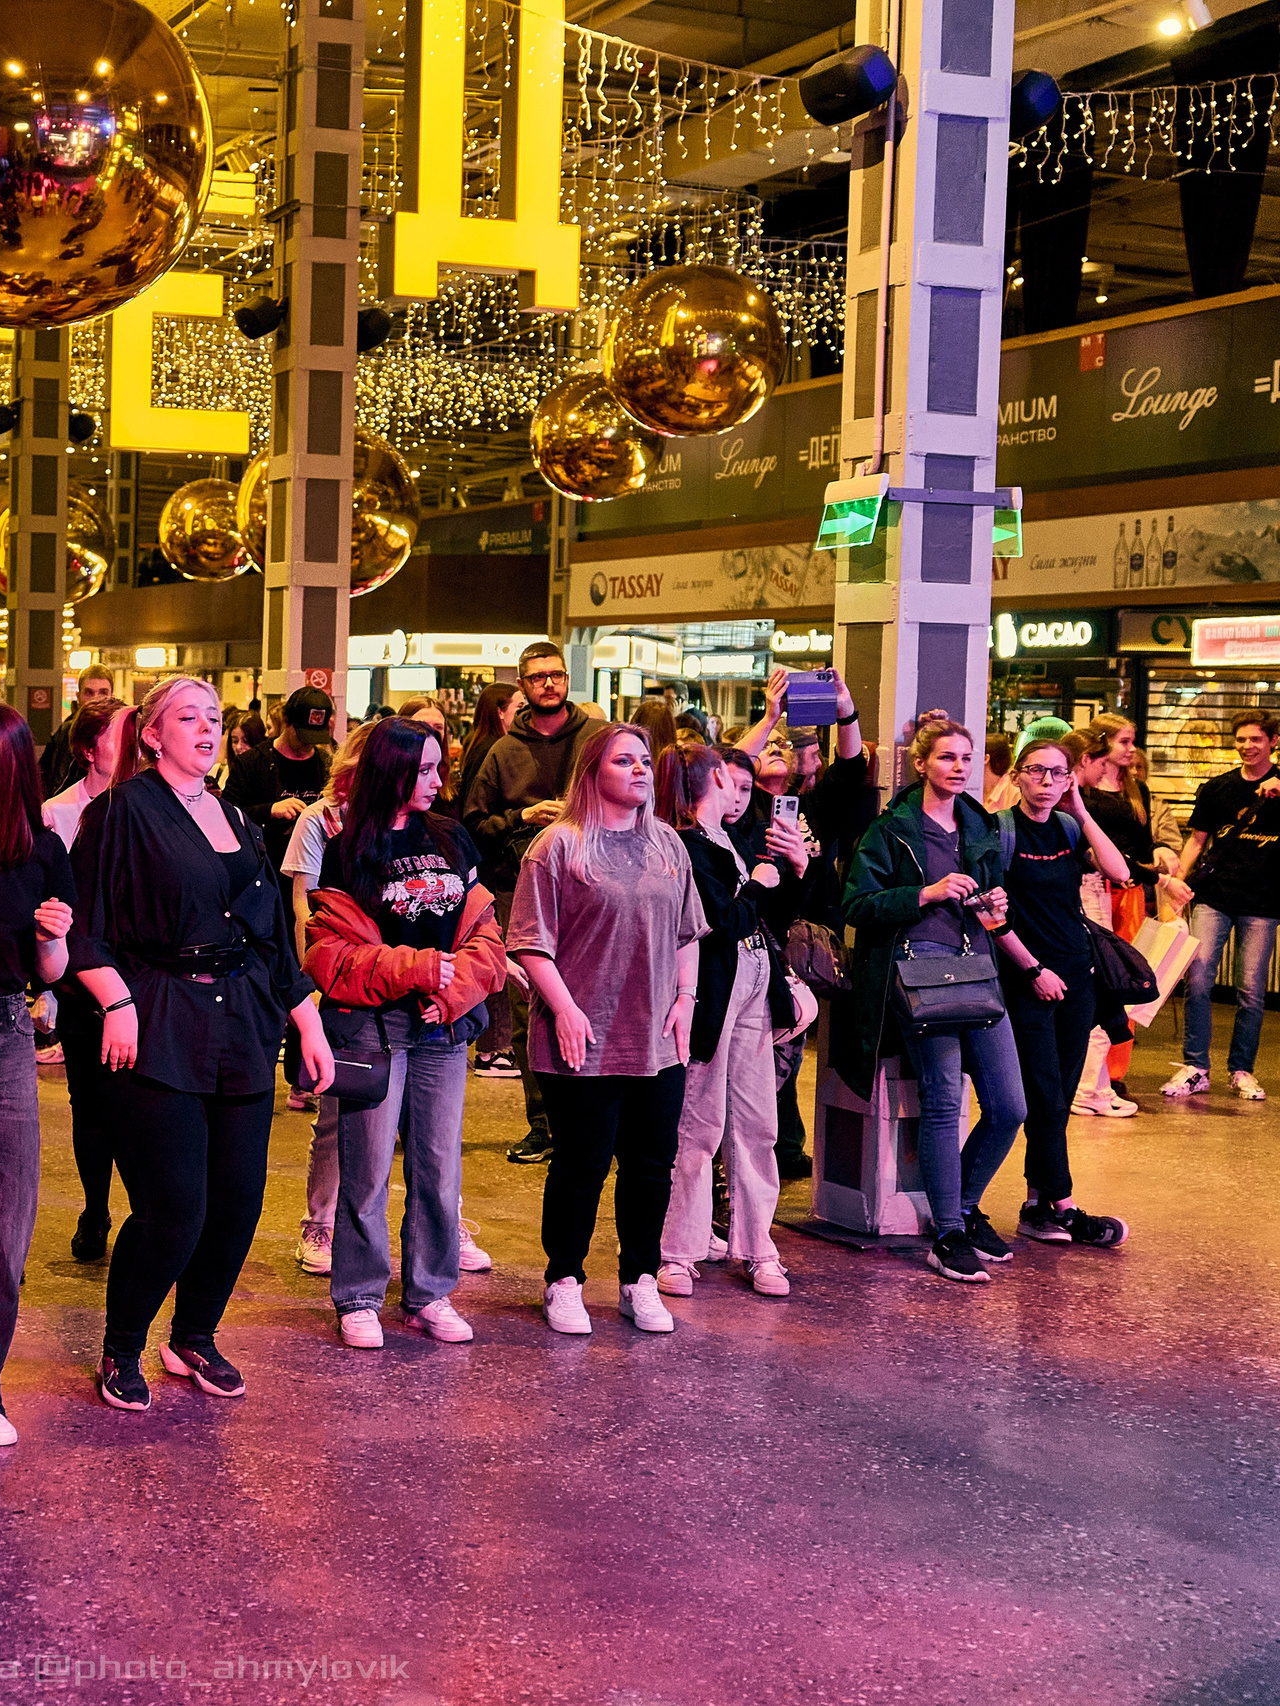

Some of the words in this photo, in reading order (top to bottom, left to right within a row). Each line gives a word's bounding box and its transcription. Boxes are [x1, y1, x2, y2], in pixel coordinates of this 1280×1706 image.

[998, 394, 1058, 426] MIUM
[1111, 366, 1219, 432] Lounge
[715, 437, 778, 488] Lounge
[609, 573, 664, 600] TASSAY
[1020, 621, 1093, 648] CACAO
